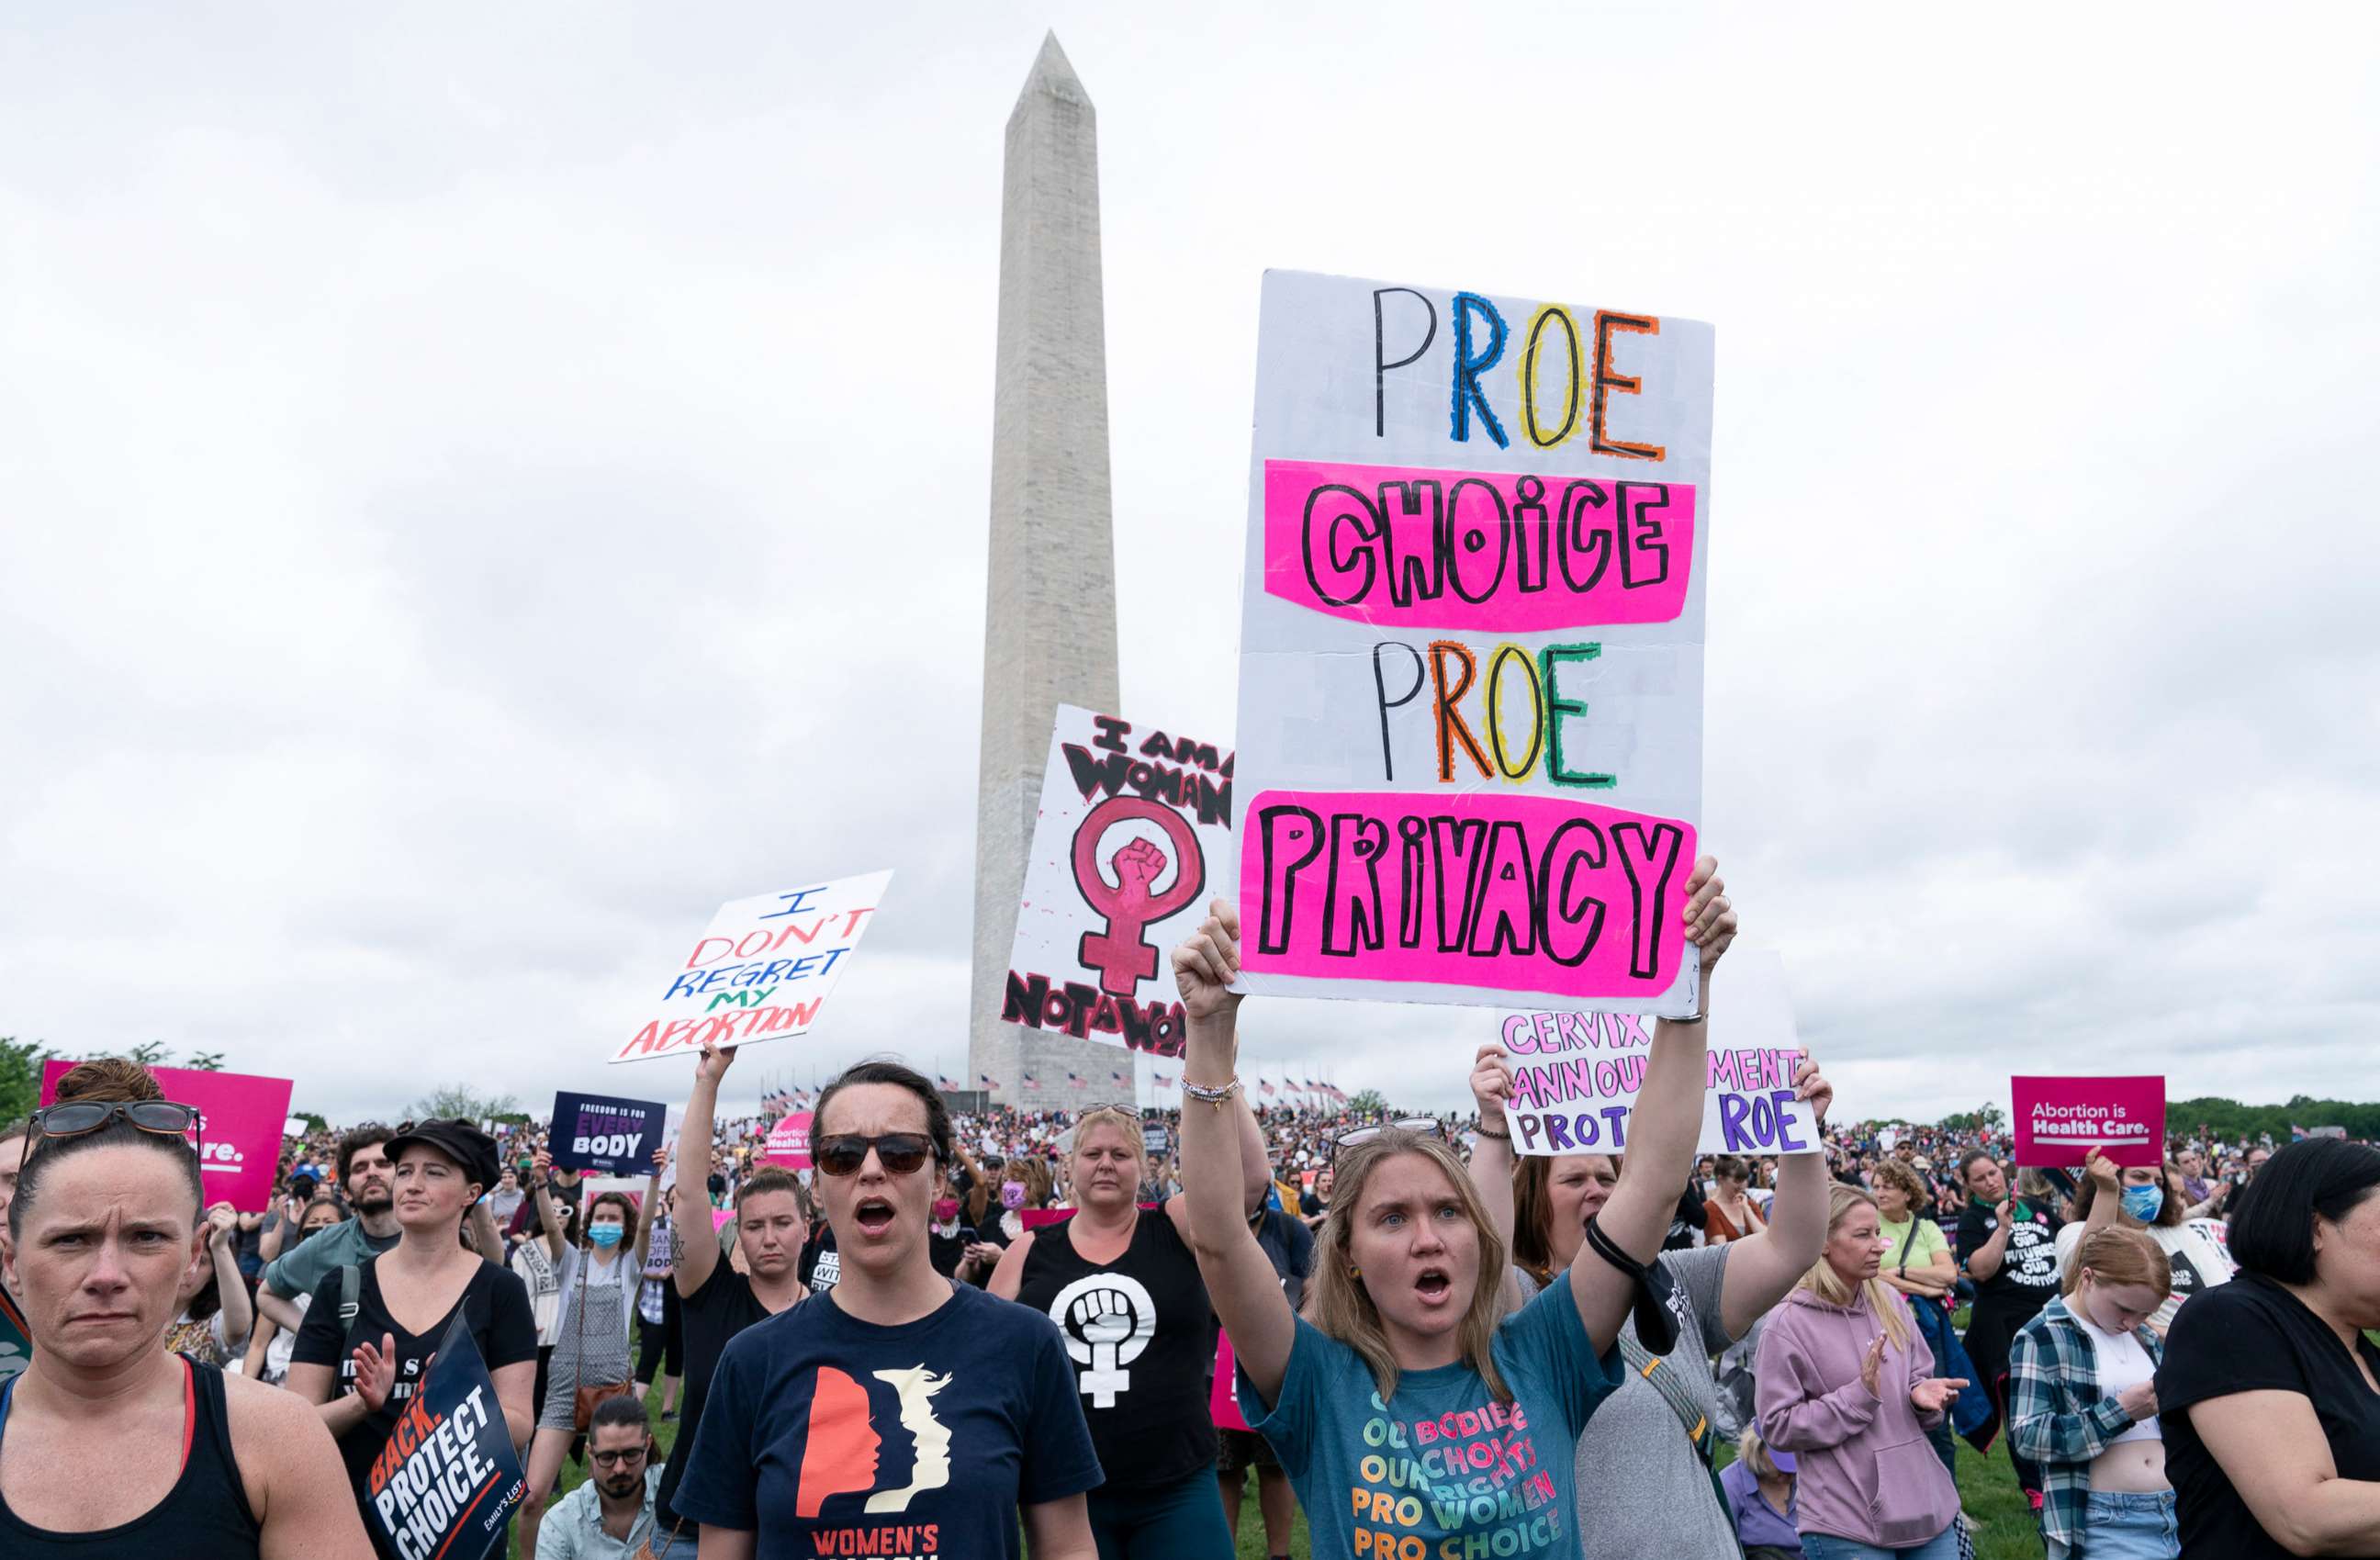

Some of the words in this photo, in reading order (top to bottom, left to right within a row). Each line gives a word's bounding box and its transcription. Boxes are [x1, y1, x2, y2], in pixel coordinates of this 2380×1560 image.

[1374, 287, 1667, 462] PROE
[1373, 639, 1618, 790] PROE
[1093, 714, 1131, 755] I
[1139, 731, 1219, 772] AM
[758, 886, 827, 919] I
[686, 907, 876, 969] DON'T
[662, 948, 850, 1001] REGRET
[705, 986, 778, 1013] MY
[1001, 969, 1100, 1040] NOT
[618, 997, 823, 1058] ABORTION
[1501, 1011, 1651, 1055] CERVIX
[575, 1112, 644, 1137] EVERY
[579, 1103, 618, 1116] FREEDOM
[619, 1107, 628, 1117] IS
[630, 1108, 646, 1119] FOR
[1516, 1105, 1633, 1151] PROT
[1718, 1090, 1807, 1152] ROE
[2031, 1102, 2108, 1118] Abortion
[2113, 1103, 2127, 1118] is
[2032, 1119, 2099, 1136] Health
[2102, 1119, 2150, 1136] Care.
[572, 1132, 643, 1159] BODY
[2004, 1242, 2056, 1264] FUTURES
[2013, 1232, 2039, 1248] OUR
[2022, 1260, 2050, 1274] OUR
[376, 1385, 488, 1536] PROTECT
[396, 1442, 496, 1560] CHOICE.
[1352, 1487, 1423, 1528] PRO
[1431, 1469, 1557, 1531] WOMEN
[811, 1523, 939, 1556] WOMEN'S
[1354, 1527, 1427, 1560] PRO
[1439, 1508, 1562, 1560] CHOICE
